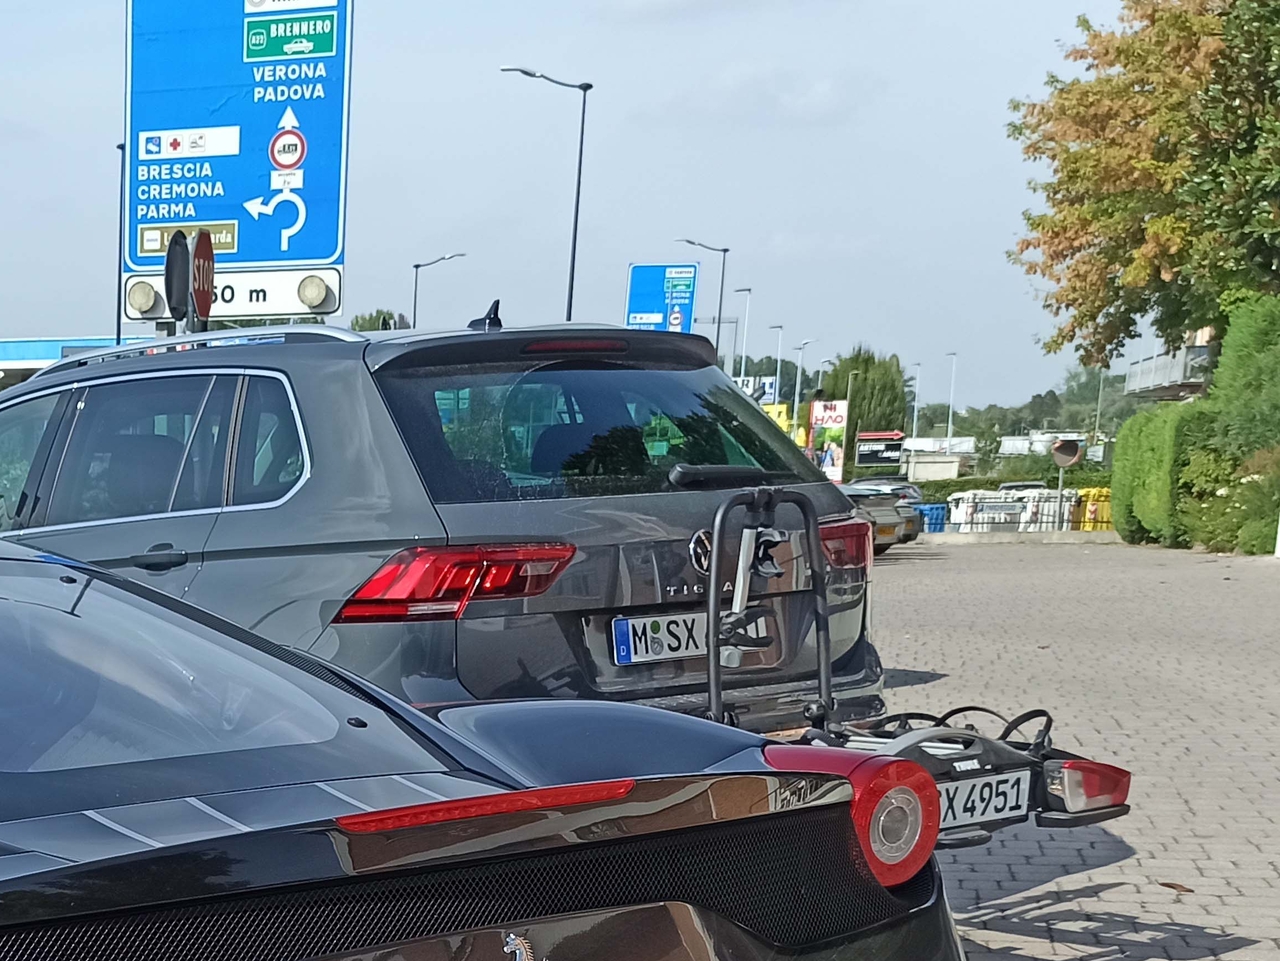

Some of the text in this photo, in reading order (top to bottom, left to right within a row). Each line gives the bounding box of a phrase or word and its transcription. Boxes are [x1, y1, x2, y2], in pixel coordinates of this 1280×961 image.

[270, 20, 331, 38] BRENNERO
[251, 34, 264, 45] A22
[253, 62, 326, 82] VERONA
[254, 83, 325, 103] PADOVA
[137, 162, 212, 180] BRESCIA
[137, 181, 224, 200] CREMONA
[137, 202, 196, 219] PARMA
[210, 230, 232, 244] arda
[194, 258, 213, 292] STOP
[249, 288, 267, 303] m
[632, 622, 649, 656] M
[620, 645, 627, 656] D
